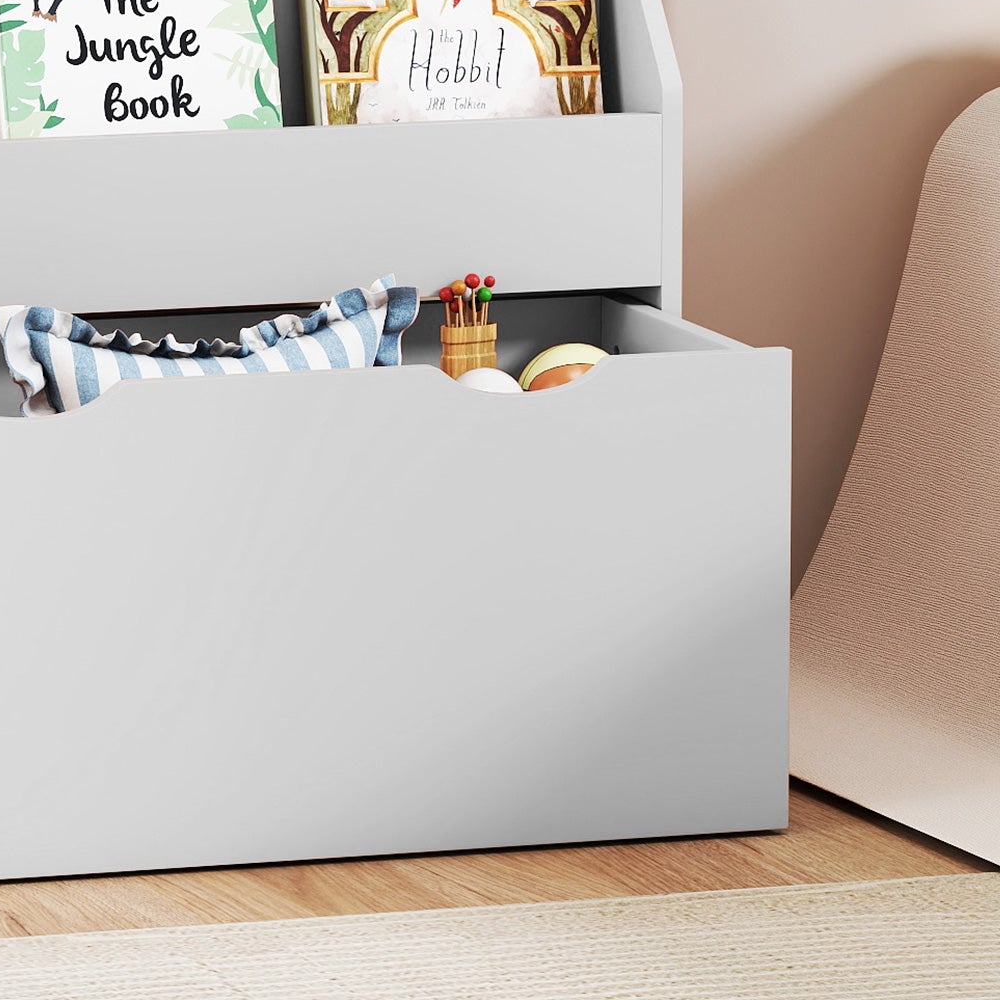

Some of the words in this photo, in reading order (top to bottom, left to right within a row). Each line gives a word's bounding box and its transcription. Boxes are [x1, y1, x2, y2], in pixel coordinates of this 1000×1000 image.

[66, 16, 200, 80] Jungle
[440, 29, 454, 43] the
[408, 27, 506, 92] Hobbit
[452, 97, 487, 111] Tolkien
